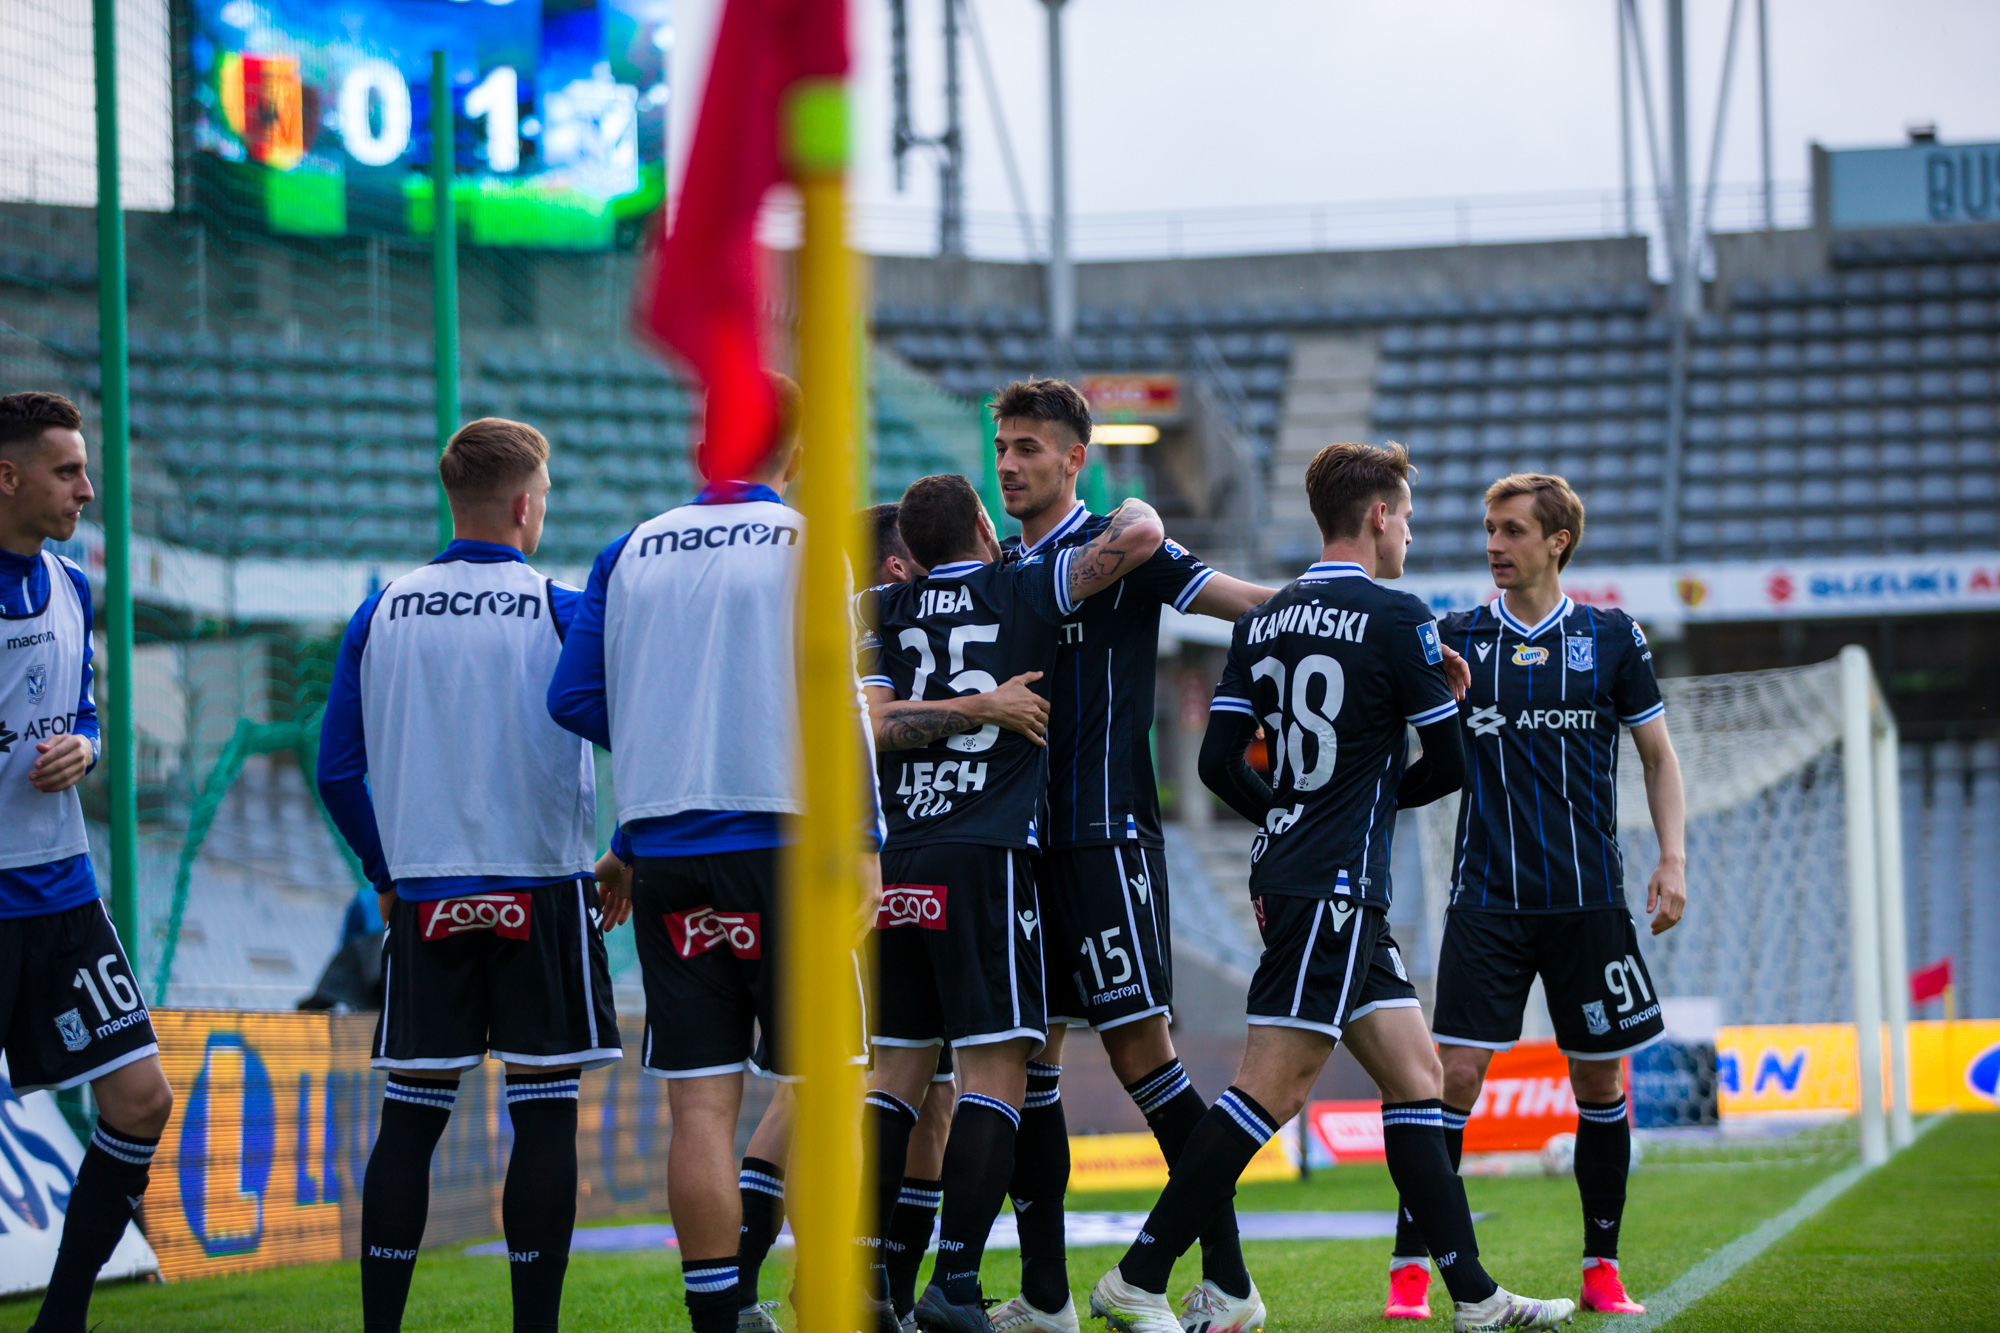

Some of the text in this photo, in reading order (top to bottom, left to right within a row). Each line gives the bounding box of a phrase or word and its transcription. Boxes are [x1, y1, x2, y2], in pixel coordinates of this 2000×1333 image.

[339, 58, 519, 172] 0 1
[1927, 153, 2000, 222] BU
[639, 523, 799, 558] macron
[390, 591, 540, 621] macron
[1247, 598, 1369, 646] KAMIŃSKI
[7, 631, 55, 650] macron
[1520, 650, 1542, 662] LOTTO
[1250, 654, 1345, 792] 38
[1516, 709, 1597, 730] AFORTI
[896, 761, 988, 796] LECH
[904, 787, 952, 820] Pils
[1080, 926, 1132, 990] 15
[73, 954, 138, 1021] 16
[1092, 983, 1141, 1006] macron
[1604, 955, 1651, 1013] 91
[96, 1009, 148, 1038] macron
[1619, 1003, 1660, 1030] macron
[370, 1245, 417, 1260] NSNP
